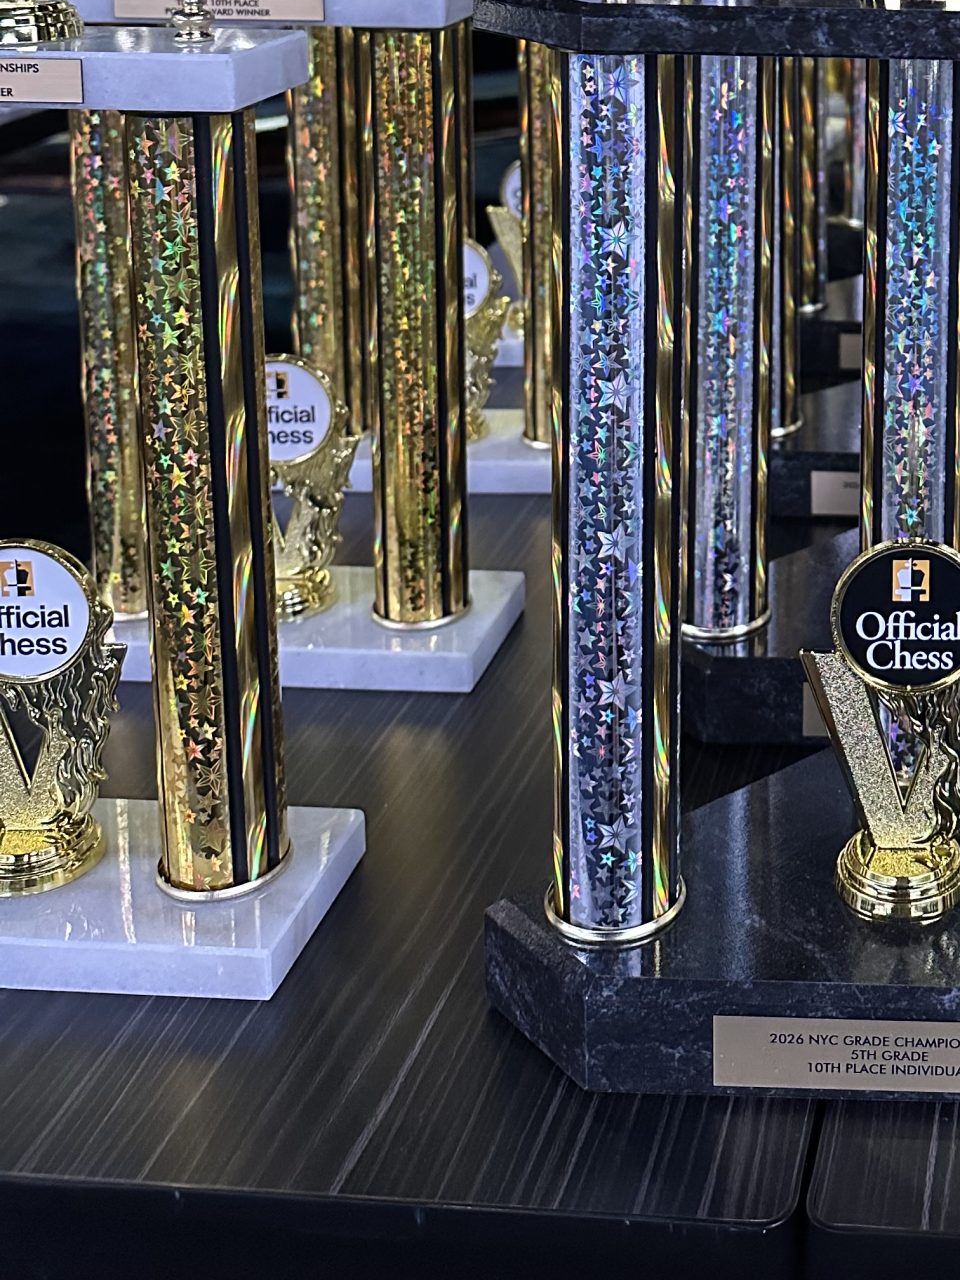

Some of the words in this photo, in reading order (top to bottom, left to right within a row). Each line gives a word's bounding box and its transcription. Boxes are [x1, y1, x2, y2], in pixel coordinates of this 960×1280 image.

[211, 0, 232, 7] 10TH
[234, 0, 260, 7] PLACE
[236, 9, 271, 17] WINNER
[268, 405, 315, 423] ficial
[0, 604, 69, 629] fficial
[0, 632, 68, 656] hess
[866, 640, 954, 670] Chess
[769, 1032, 804, 1045] 2026
[809, 1033, 839, 1046] NYC
[844, 1034, 890, 1048] GRADE
[851, 1049, 877, 1061] 5TH
[881, 1050, 929, 1062] GRADE
[807, 1061, 841, 1074] 10TH
[845, 1062, 887, 1075] PLACE
